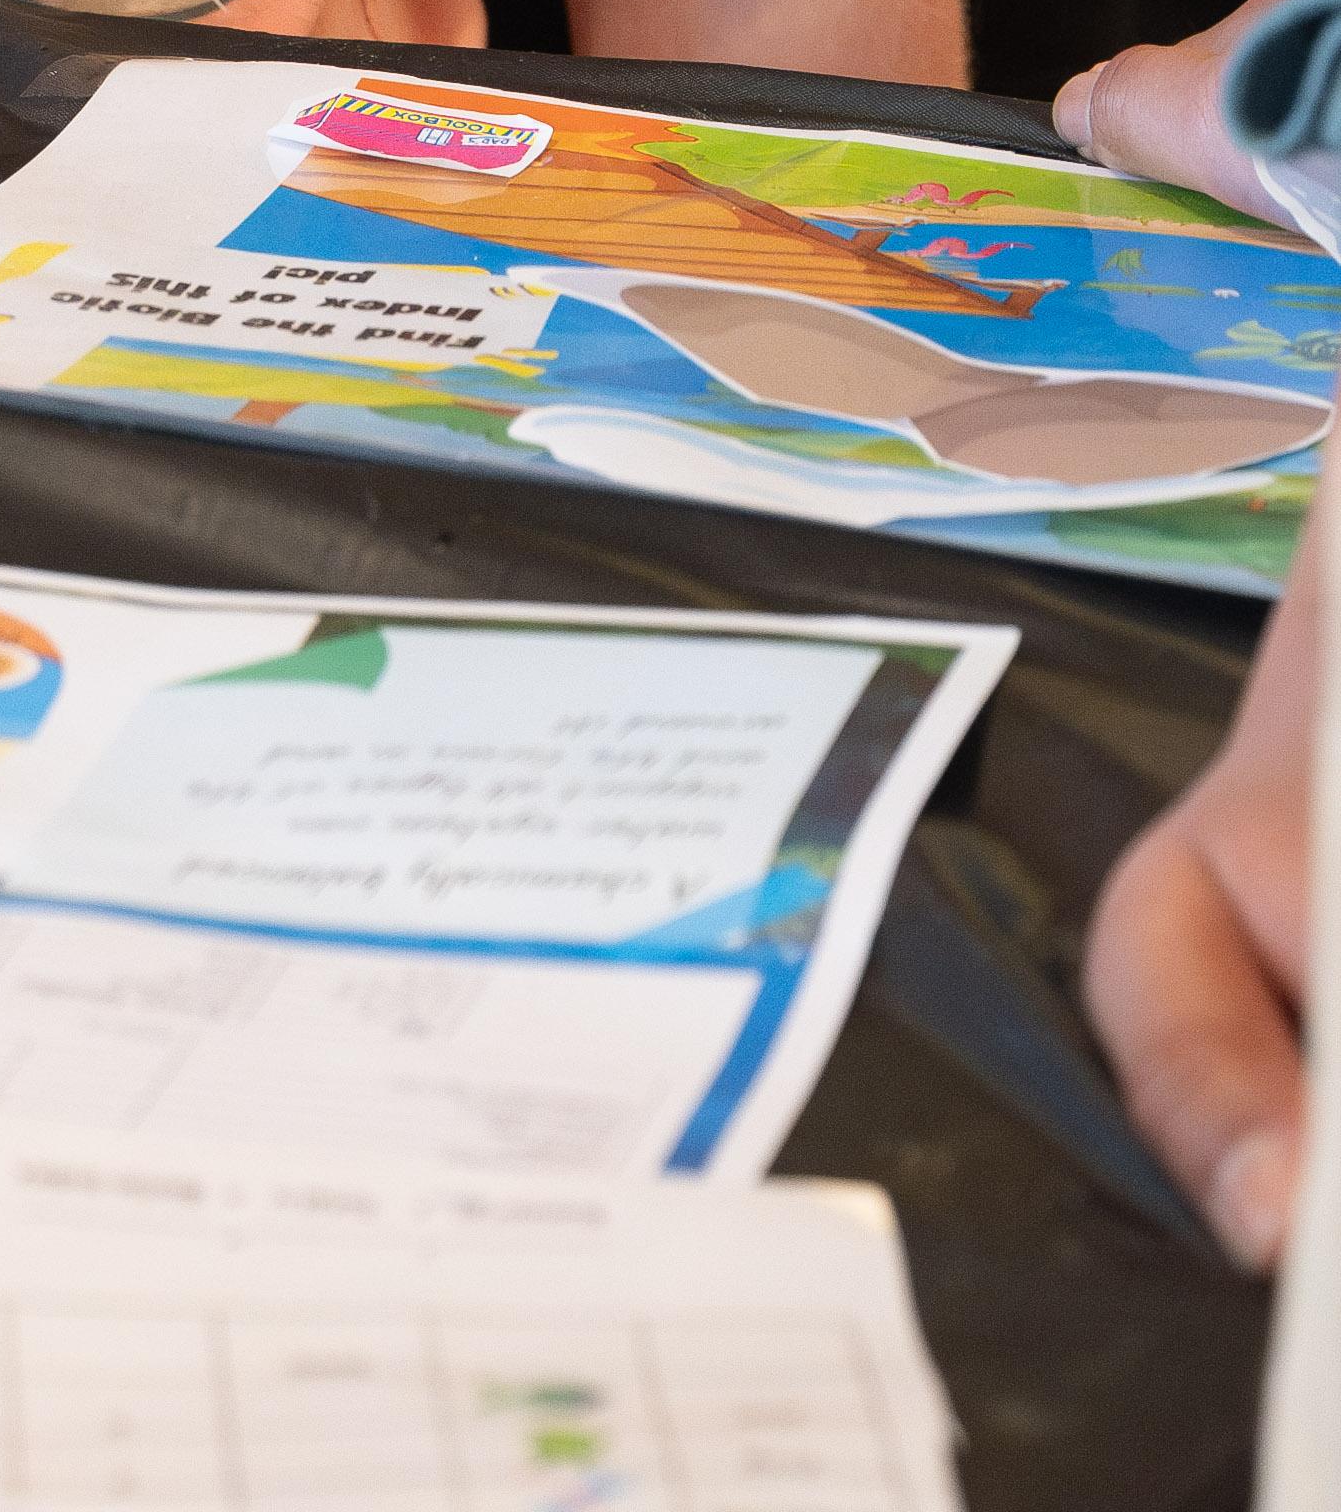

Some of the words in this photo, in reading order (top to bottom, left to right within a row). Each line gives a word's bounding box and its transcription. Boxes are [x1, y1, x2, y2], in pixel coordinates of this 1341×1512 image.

[394, 109, 496, 136] TOOLBOX
[105, 272, 212, 300] this
[261, 265, 377, 286] pic!
[50, 290, 223, 327] Biotic
[229, 290, 297, 304] of
[319, 295, 484, 323] Index
[240, 316, 337, 338] the
[355, 327, 487, 350] Find
